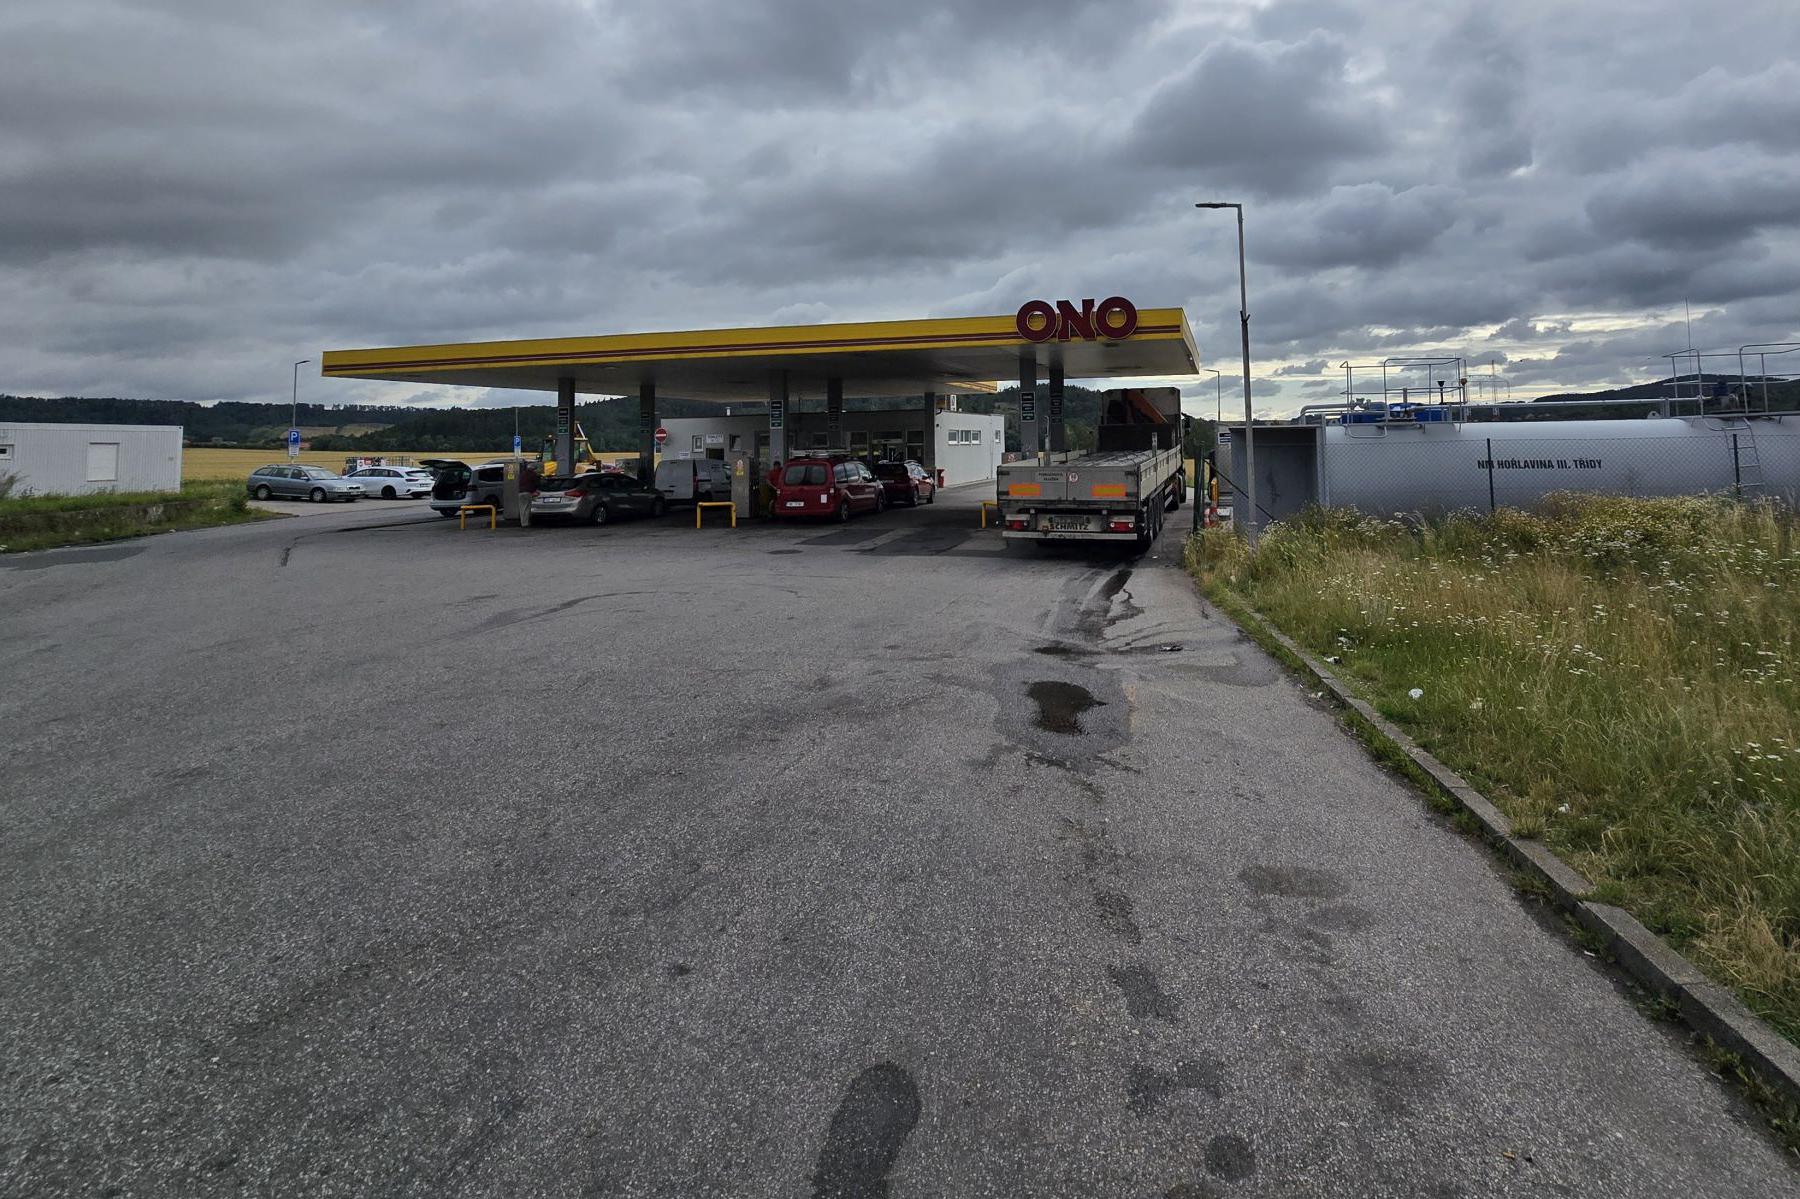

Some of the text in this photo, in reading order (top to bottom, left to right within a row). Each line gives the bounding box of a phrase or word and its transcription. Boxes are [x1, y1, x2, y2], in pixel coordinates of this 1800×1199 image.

[1016, 296, 1138, 343] ONO
[1497, 458, 1554, 470] HOŘLAVINA
[1556, 459, 1572, 469] III.
[1574, 457, 1602, 470] TŘÍDY
[1049, 522, 1089, 530] SCHMITZ
